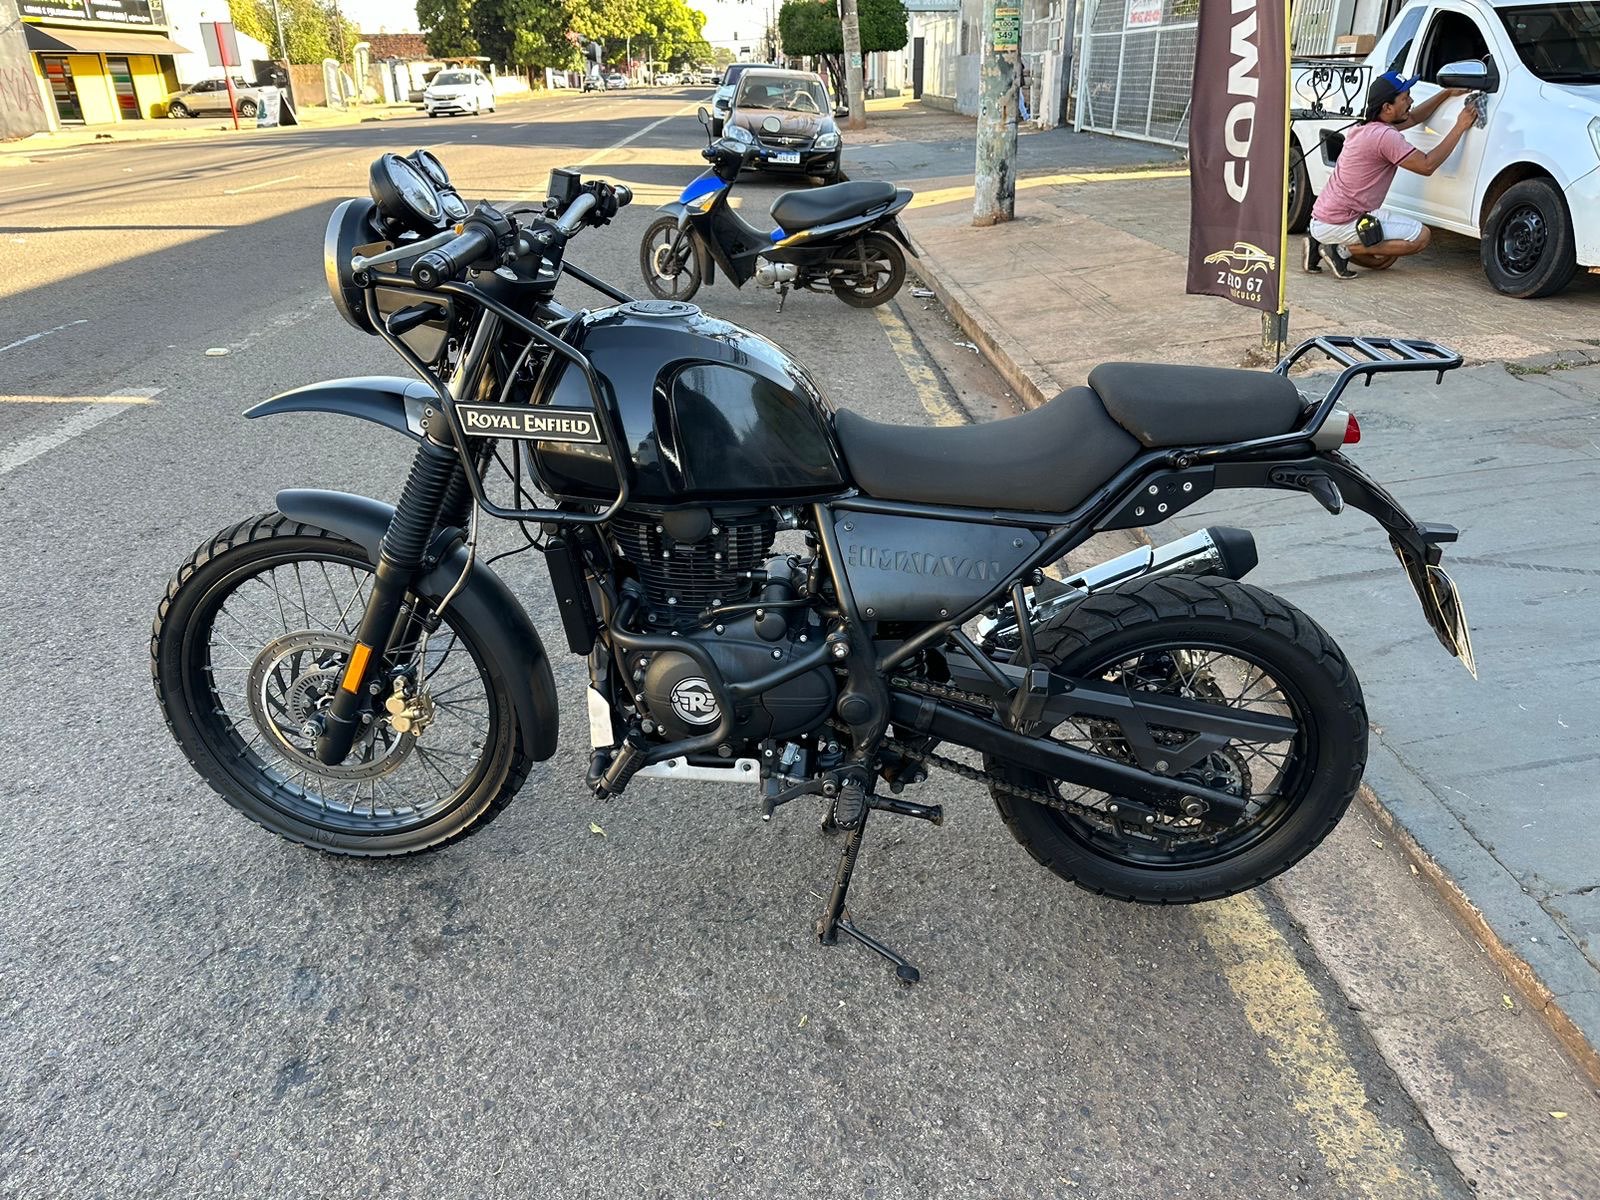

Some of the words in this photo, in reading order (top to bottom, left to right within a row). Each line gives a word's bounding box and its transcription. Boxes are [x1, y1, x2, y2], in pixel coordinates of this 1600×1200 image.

[1223, 0, 1260, 204] COM
[1246, 277, 1263, 293] 67
[466, 410, 521, 430] ROYAL
[524, 414, 591, 435] ENFIELD
[848, 544, 1000, 582] HIMALAYAN
